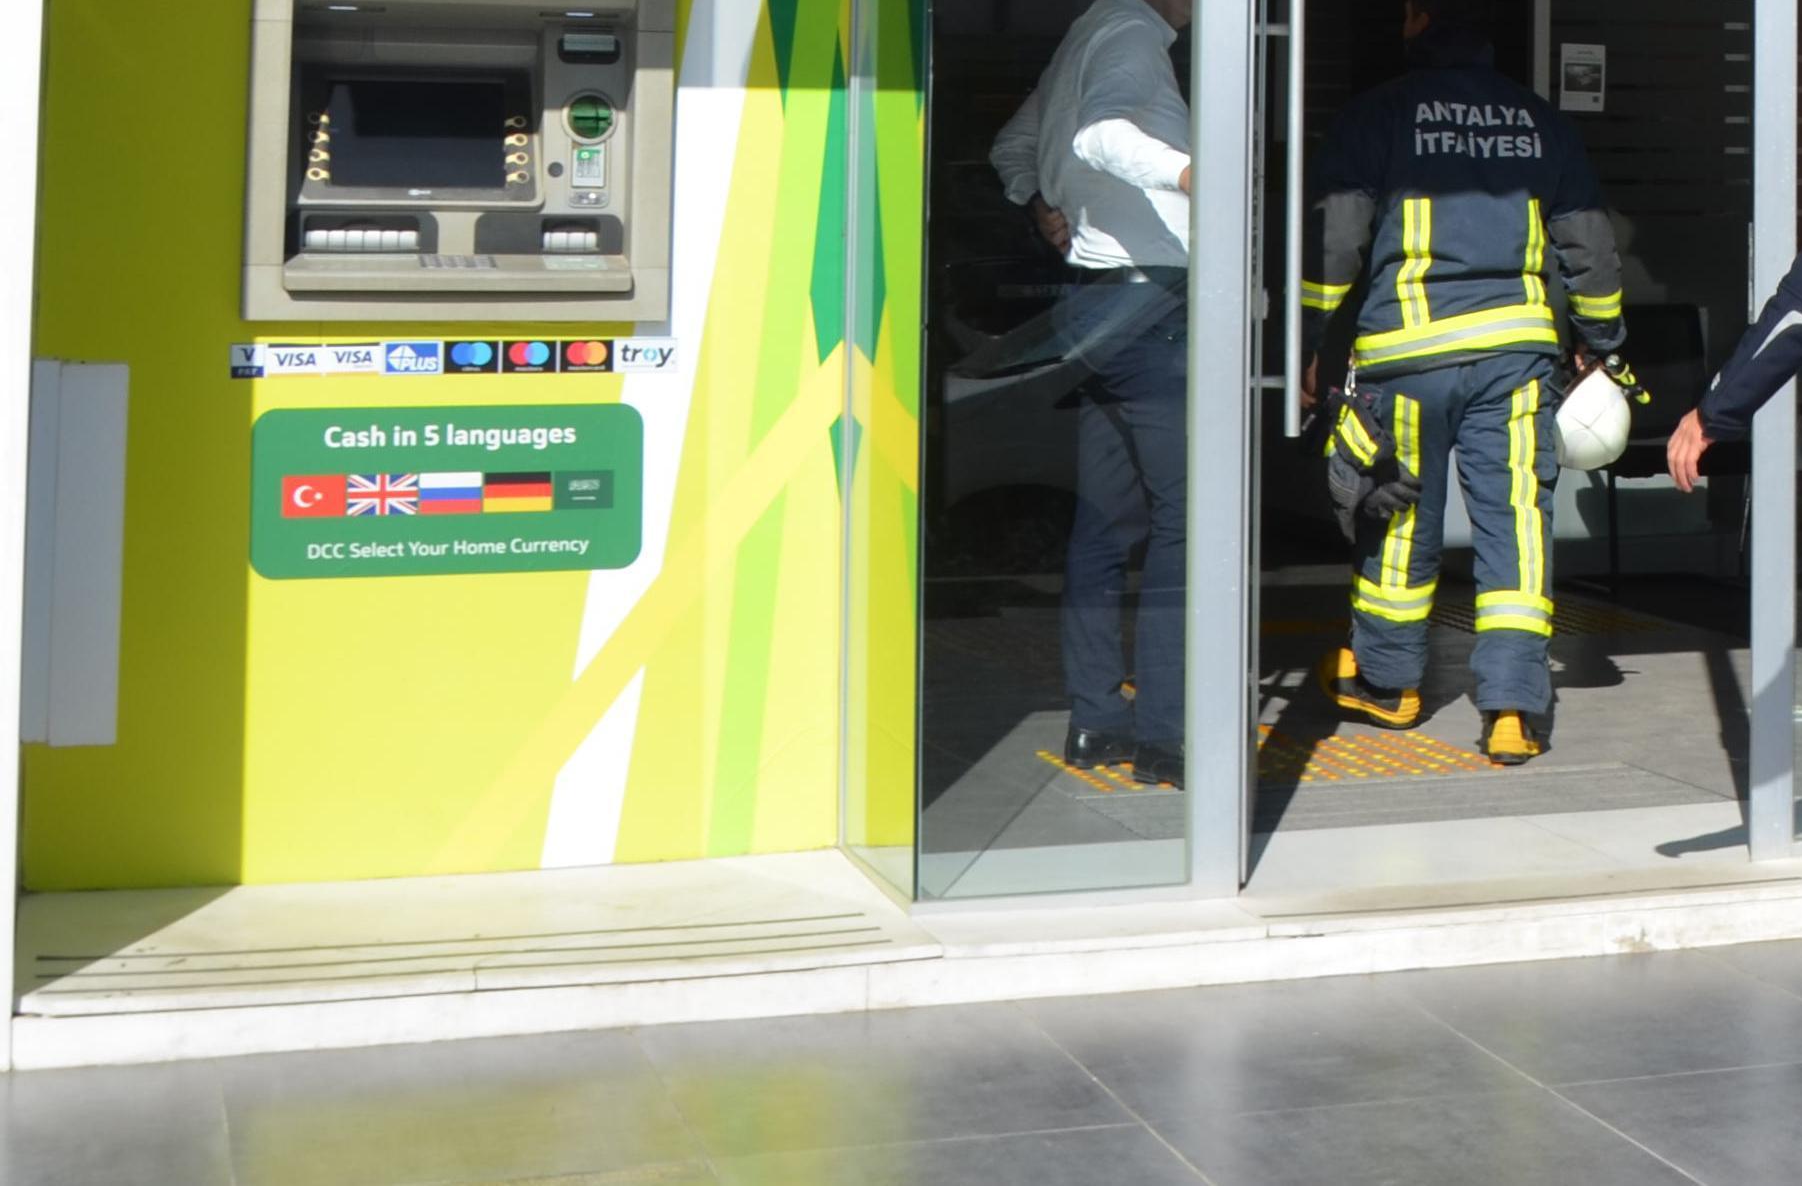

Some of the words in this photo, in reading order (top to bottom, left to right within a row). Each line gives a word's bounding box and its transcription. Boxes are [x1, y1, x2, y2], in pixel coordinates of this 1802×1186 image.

[1415, 100, 1535, 128] ANTALYA
[274, 352, 317, 367] VISA
[334, 350, 373, 364] VISA
[399, 356, 439, 372] PLUS
[621, 344, 673, 368] troy
[324, 425, 386, 448] Cash
[393, 426, 417, 447] in
[424, 424, 440, 447] 5
[446, 423, 577, 451] languages
[307, 543, 344, 560] DCC
[350, 541, 404, 558] Select
[408, 541, 449, 556] Your
[453, 540, 506, 555] Home
[510, 538, 589, 555] Currency
